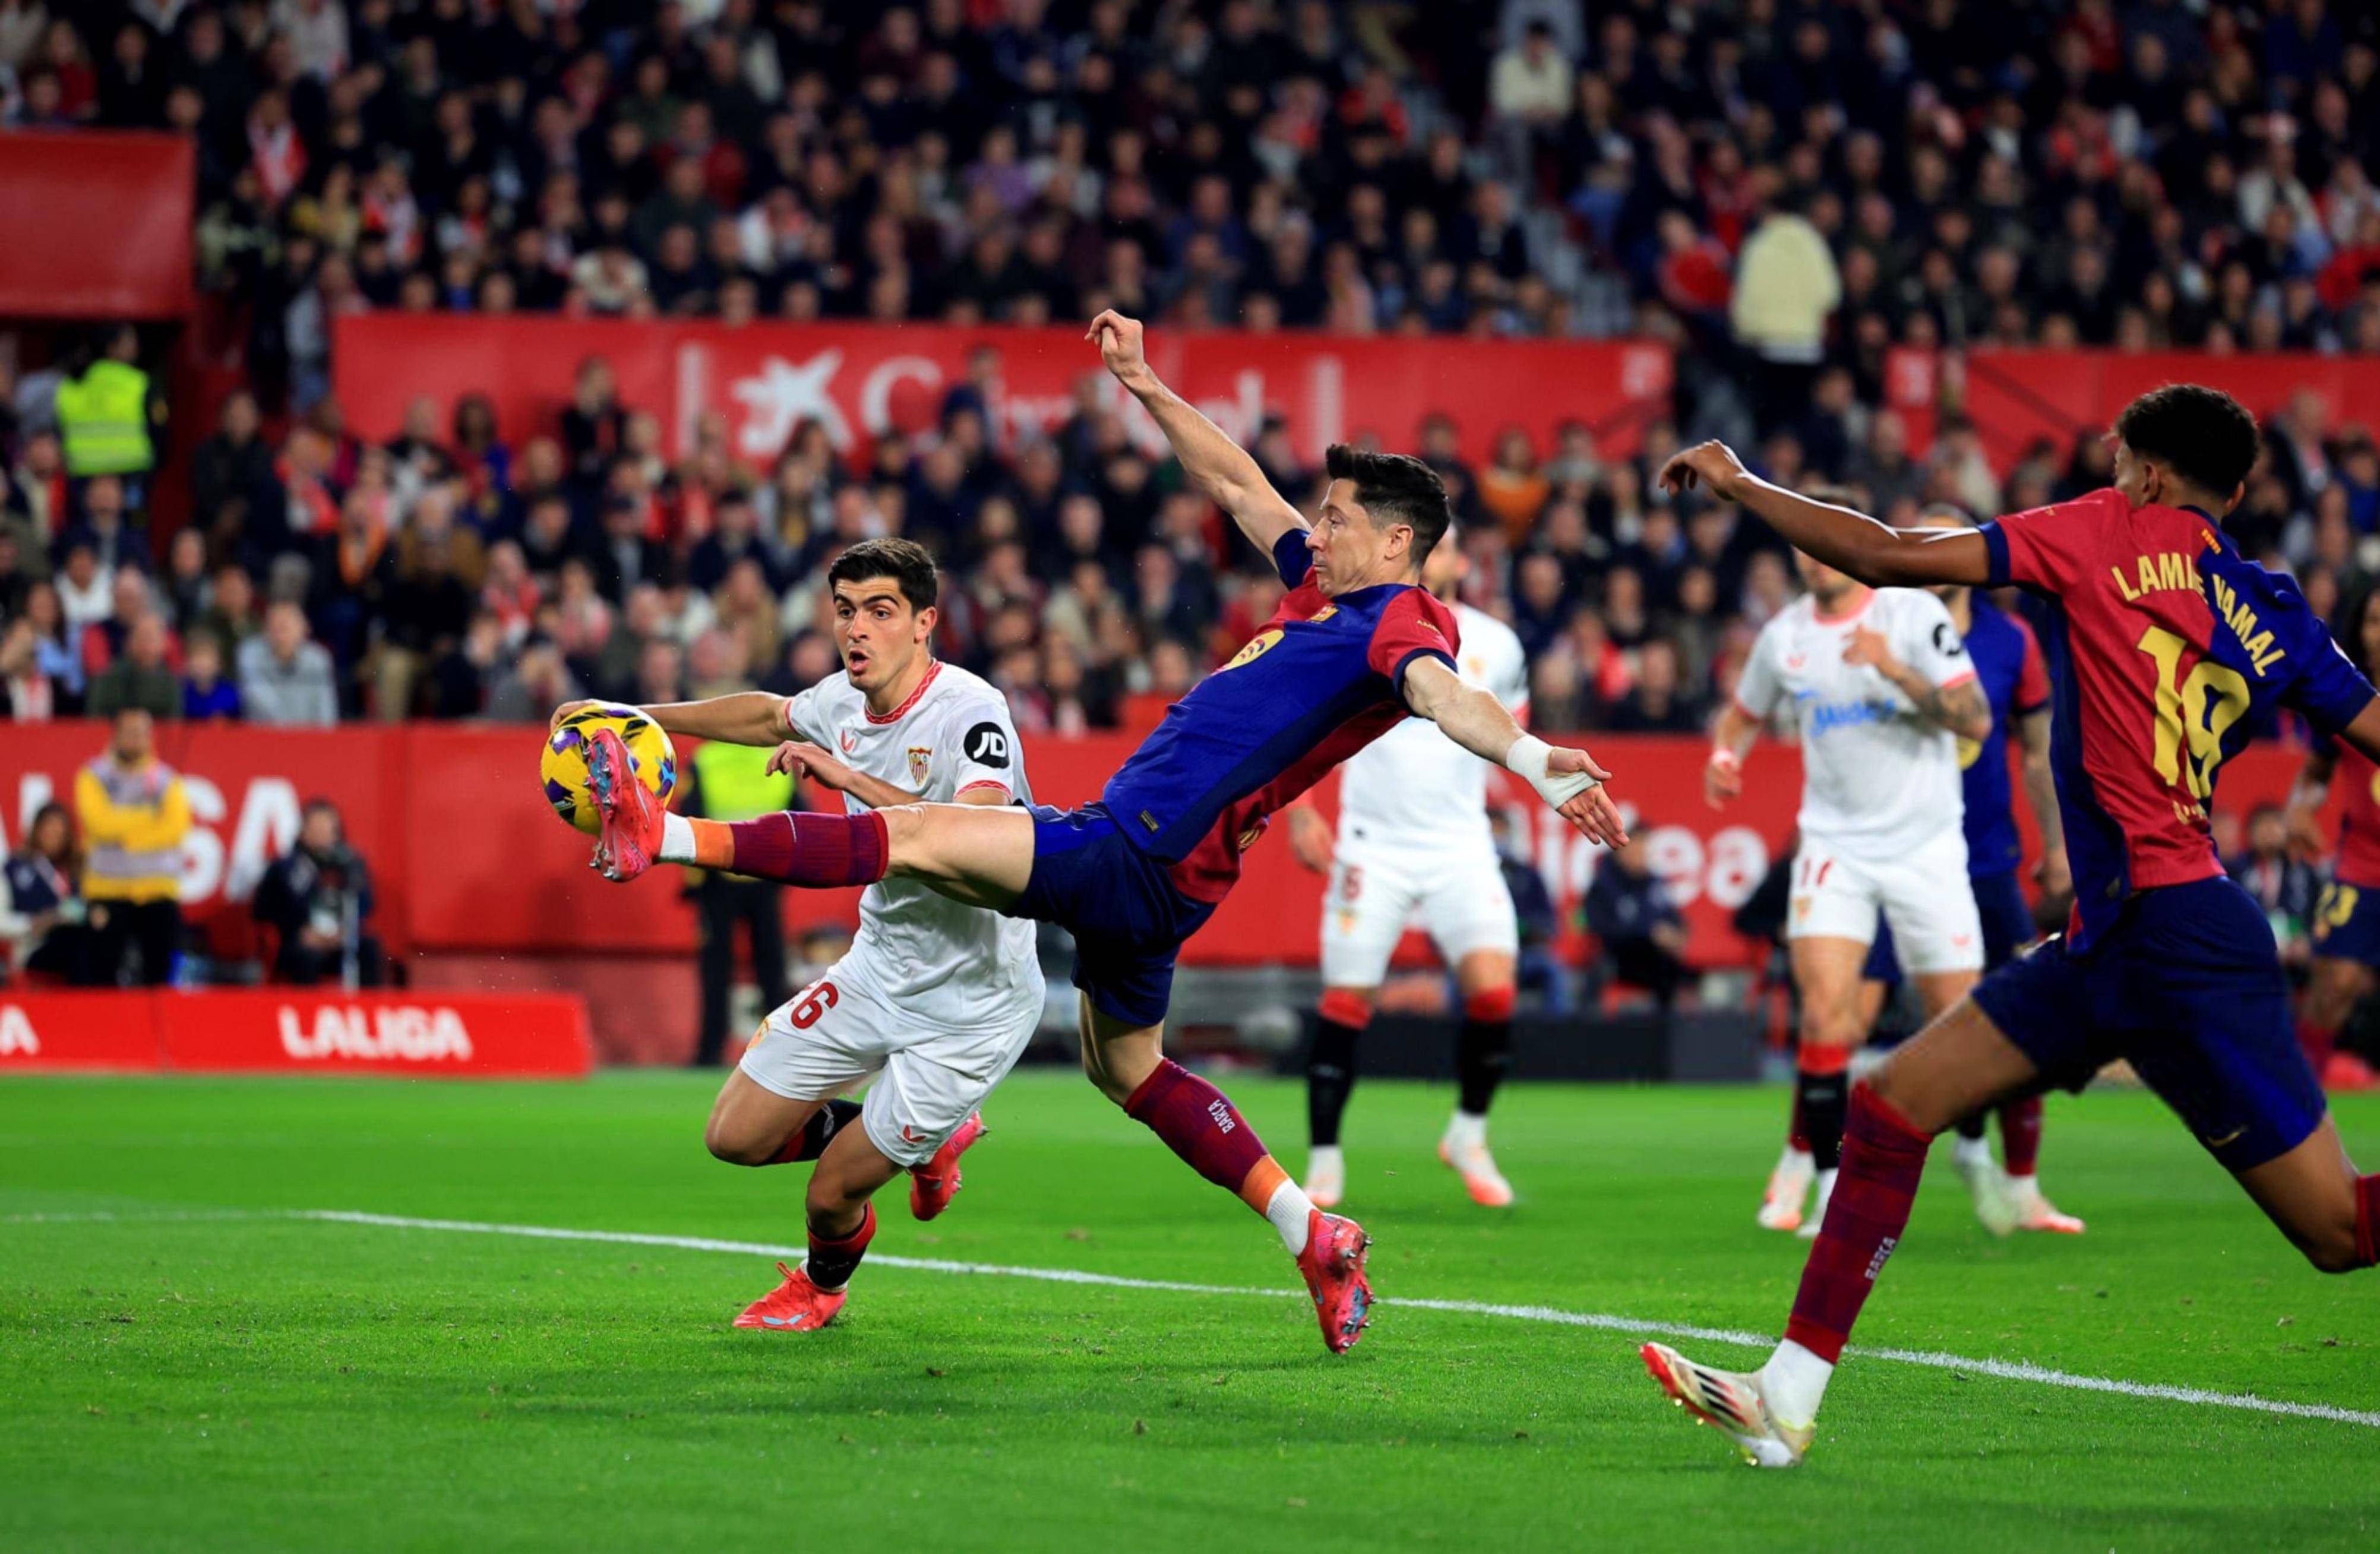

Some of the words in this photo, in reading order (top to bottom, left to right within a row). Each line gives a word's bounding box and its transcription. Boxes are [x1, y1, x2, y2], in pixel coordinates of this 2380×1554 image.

[2213, 574, 2286, 677] YAMAL
[2138, 624, 2250, 798] 19
[974, 731, 1007, 759] JD
[277, 1004, 473, 1061] LALIGA
[1208, 1099, 1235, 1134] BARÇA
